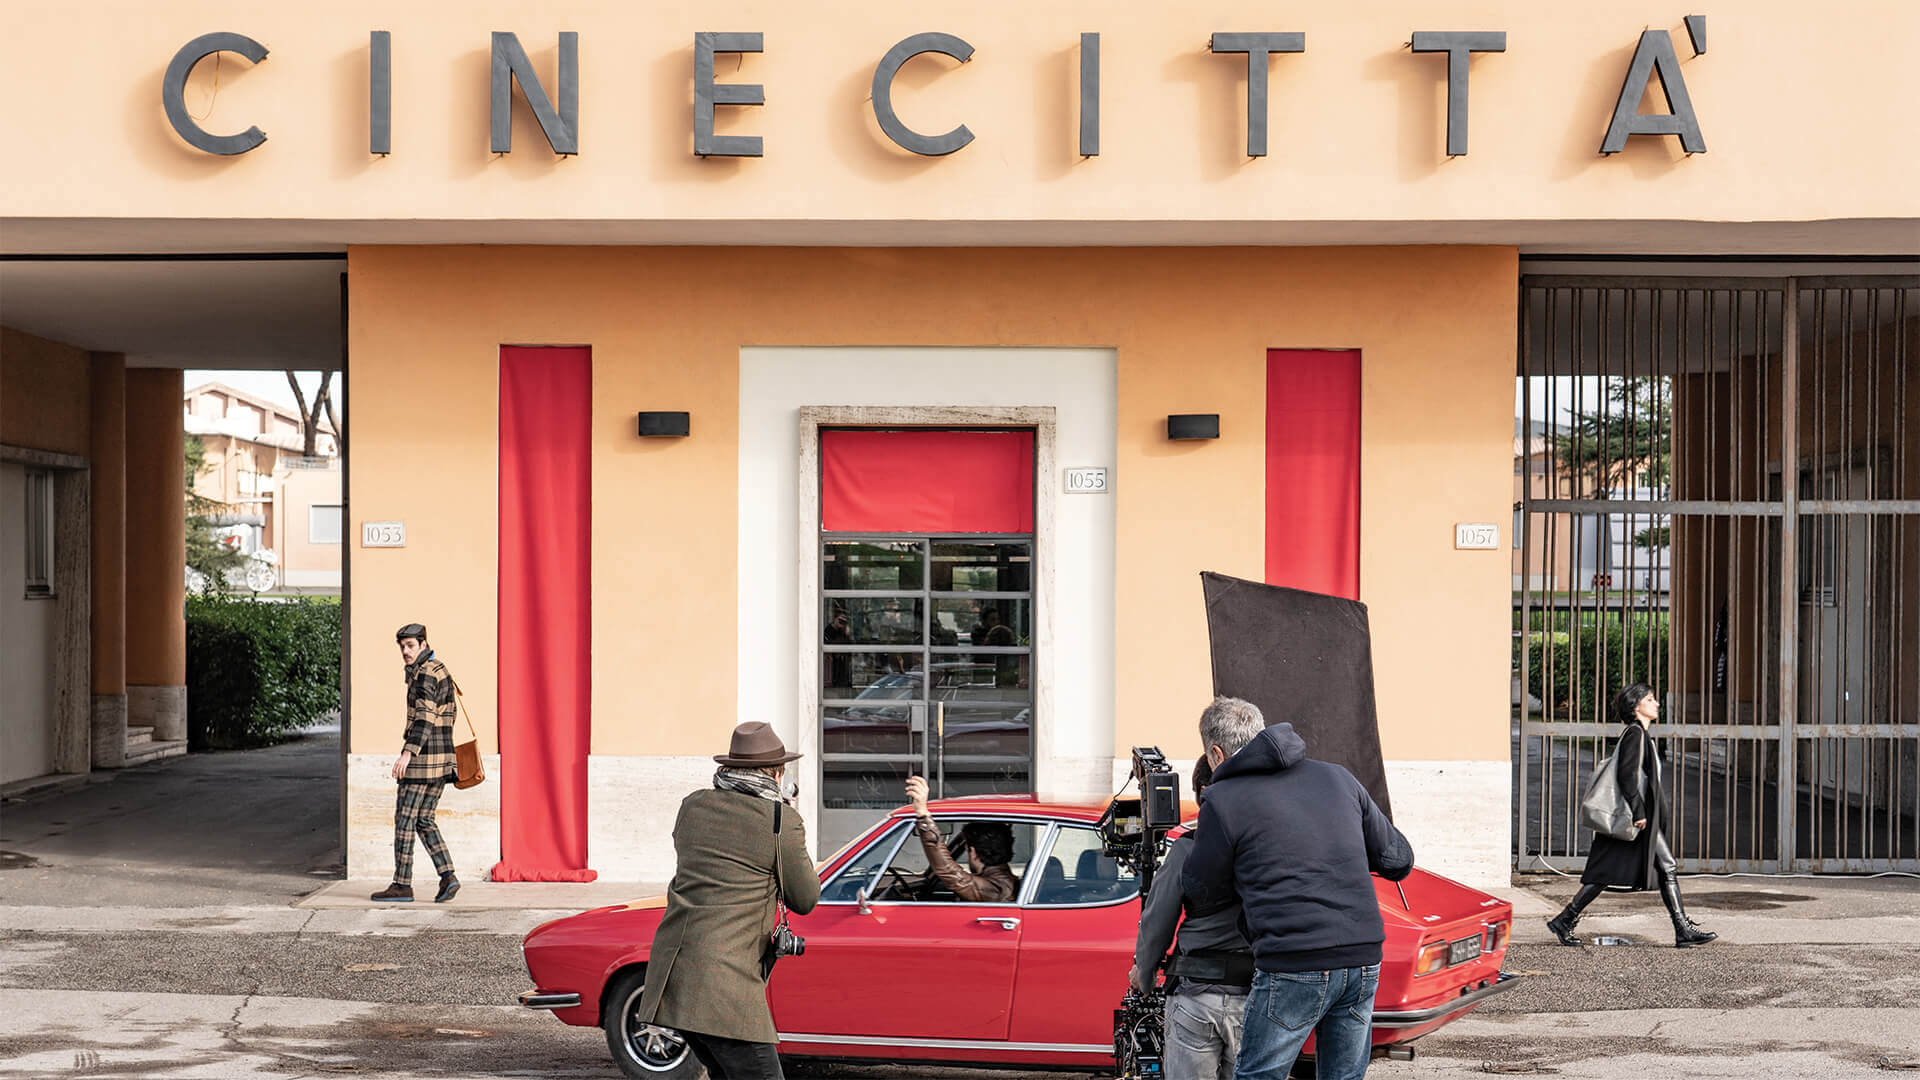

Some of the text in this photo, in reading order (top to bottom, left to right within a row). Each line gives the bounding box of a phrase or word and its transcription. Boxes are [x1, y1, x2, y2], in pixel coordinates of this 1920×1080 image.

[1070, 472, 1104, 488] 1055
[367, 527, 401, 542] 1053
[1462, 528, 1494, 544] 1057
